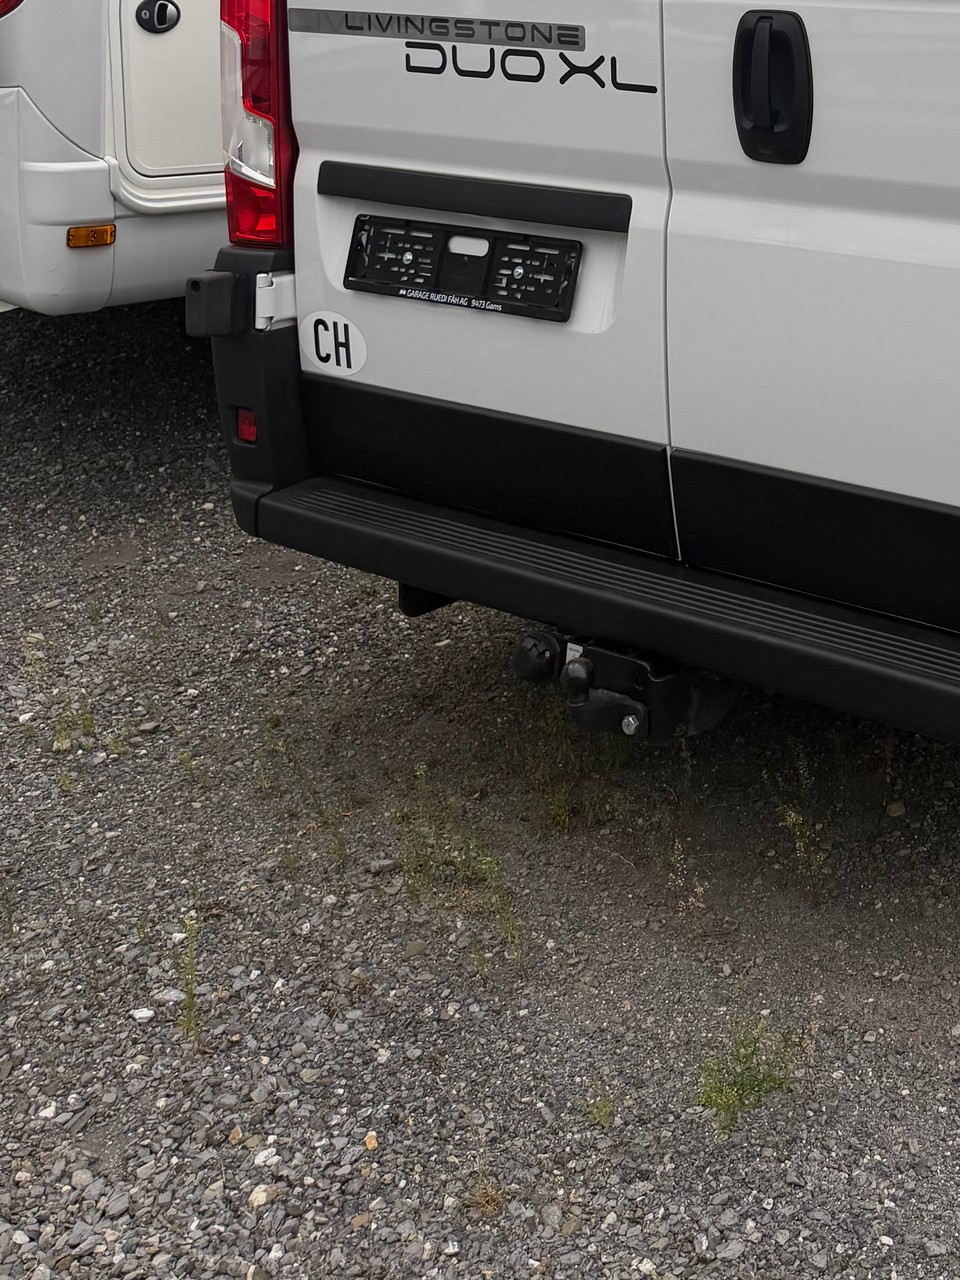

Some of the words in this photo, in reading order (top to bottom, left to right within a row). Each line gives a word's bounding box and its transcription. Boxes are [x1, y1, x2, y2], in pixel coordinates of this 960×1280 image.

[344, 12, 581, 47] LIVINGSTONE
[406, 289, 430, 300] GARAGE
[429, 292, 448, 303] RUEDI
[459, 297, 469, 306] AG
[470, 299, 486, 309] 9473
[485, 301, 503, 312] Gams
[313, 317, 353, 370] CH
